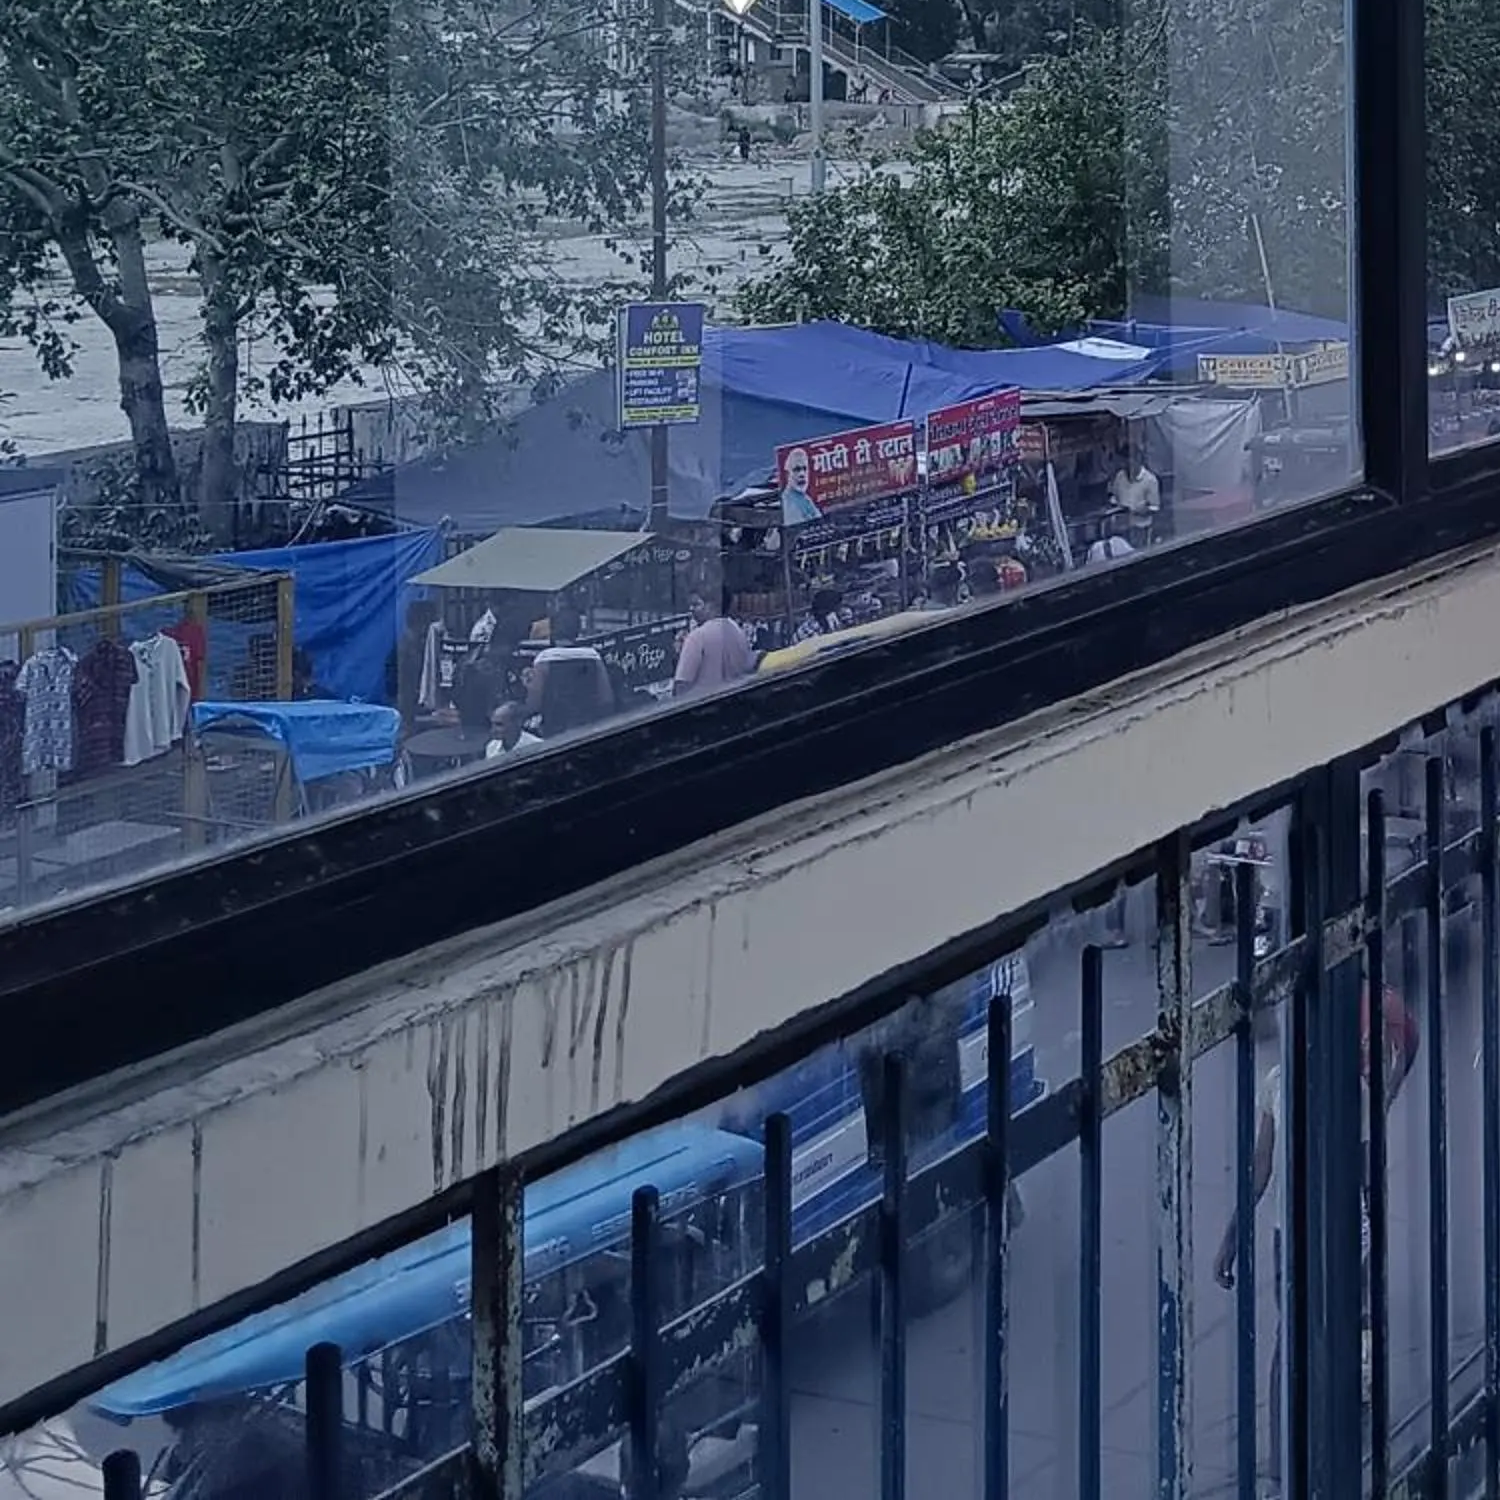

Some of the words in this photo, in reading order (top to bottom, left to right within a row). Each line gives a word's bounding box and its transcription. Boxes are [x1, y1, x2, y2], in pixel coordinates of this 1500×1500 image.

[643, 331, 686, 344] HOTEL
[629, 346, 677, 357] COMFORT
[811, 443, 850, 473] मोदी
[854, 438, 872, 465] टी
[876, 434, 914, 458] स्टाल
